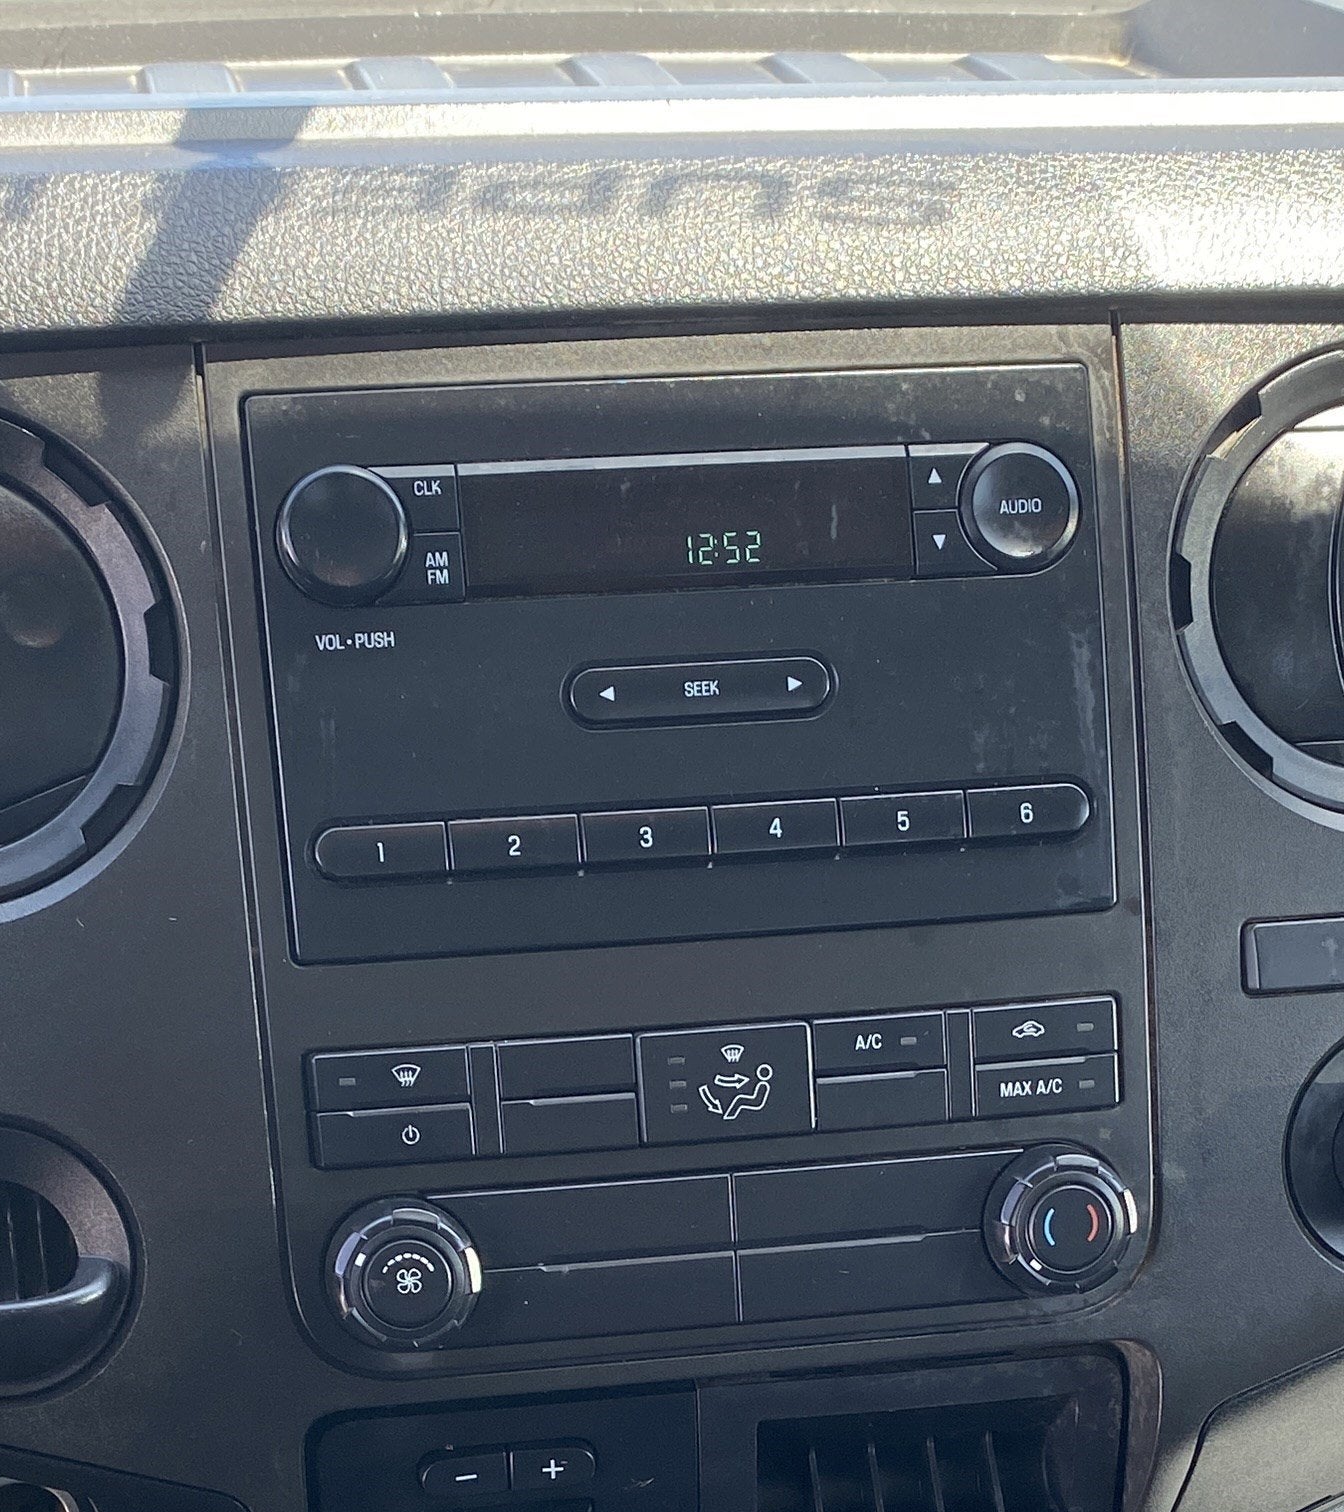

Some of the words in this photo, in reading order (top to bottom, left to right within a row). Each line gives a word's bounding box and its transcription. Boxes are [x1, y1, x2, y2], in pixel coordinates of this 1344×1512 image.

[413, 480, 442, 496] CLK
[999, 497, 1042, 515] AUDIO
[686, 530, 761, 565] 12:52
[425, 551, 449, 568] AM
[427, 569, 449, 585] FM
[684, 680, 720, 697] SEEK
[376, 842, 385, 862] 1
[508, 835, 521, 856] 2
[639, 826, 653, 848] 3
[769, 818, 782, 838] 4
[897, 811, 910, 832] 5
[1020, 803, 1034, 824] 6
[855, 1033, 882, 1050] A/C
[1000, 1081, 1032, 1097] MAX
[1036, 1078, 1062, 1095] A/C
